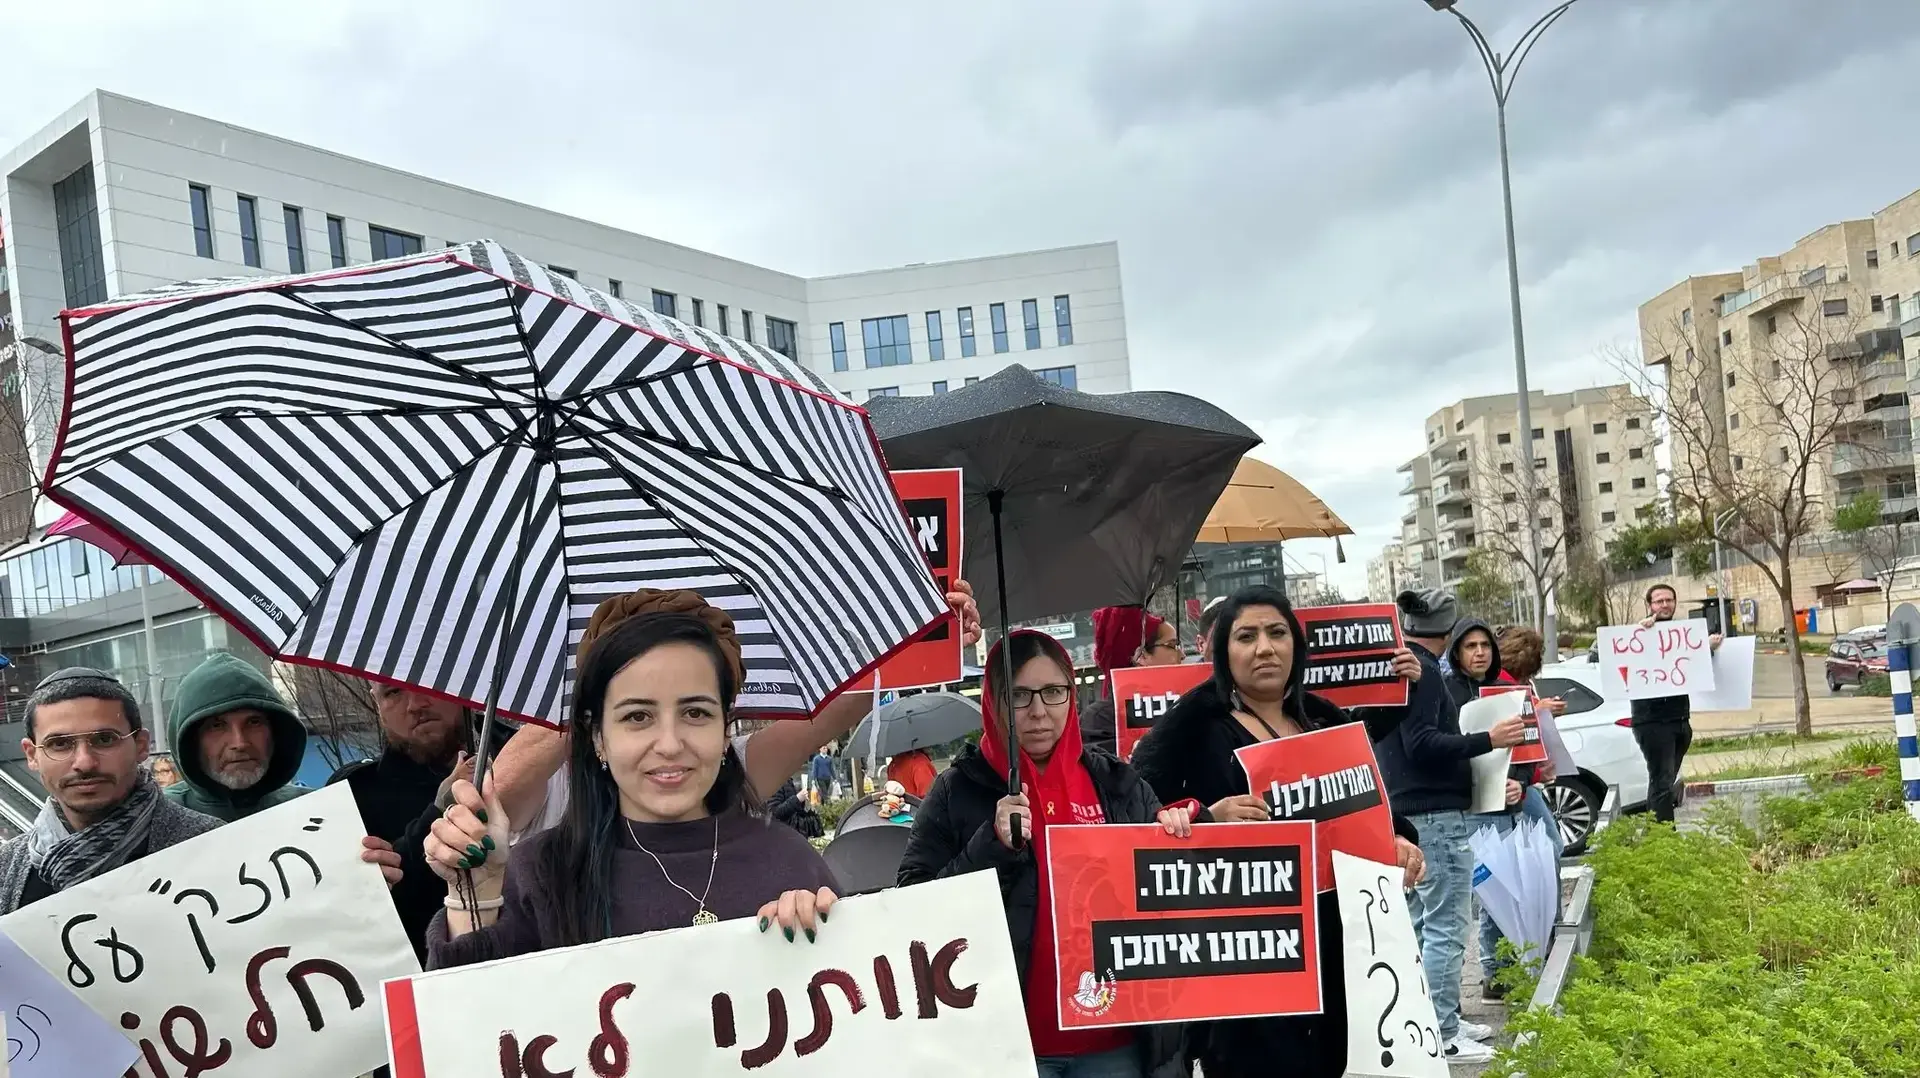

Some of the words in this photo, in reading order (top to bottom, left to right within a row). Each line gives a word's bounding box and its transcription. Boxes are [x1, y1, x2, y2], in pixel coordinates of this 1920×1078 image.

[1309, 624, 1342, 648] לבד.
[1344, 623, 1363, 645] לא
[1365, 623, 1393, 644] אתן
[1612, 628, 1646, 655] לא
[1658, 627, 1703, 660] אתן
[1347, 660, 1398, 681] אנחנו
[1270, 773, 1316, 818] לכן!
[1318, 763, 1376, 805] מאמינות
[1140, 858, 1192, 897] לבד.
[1196, 858, 1233, 895] לא
[1238, 860, 1293, 896] אתן
[1359, 875, 1390, 956] לך
[61, 913, 145, 988] על
[1110, 932, 1201, 971] איתכן
[1206, 928, 1301, 963] אנחנו
[711, 937, 978, 1070] אותנו
[499, 981, 636, 1078] לא
